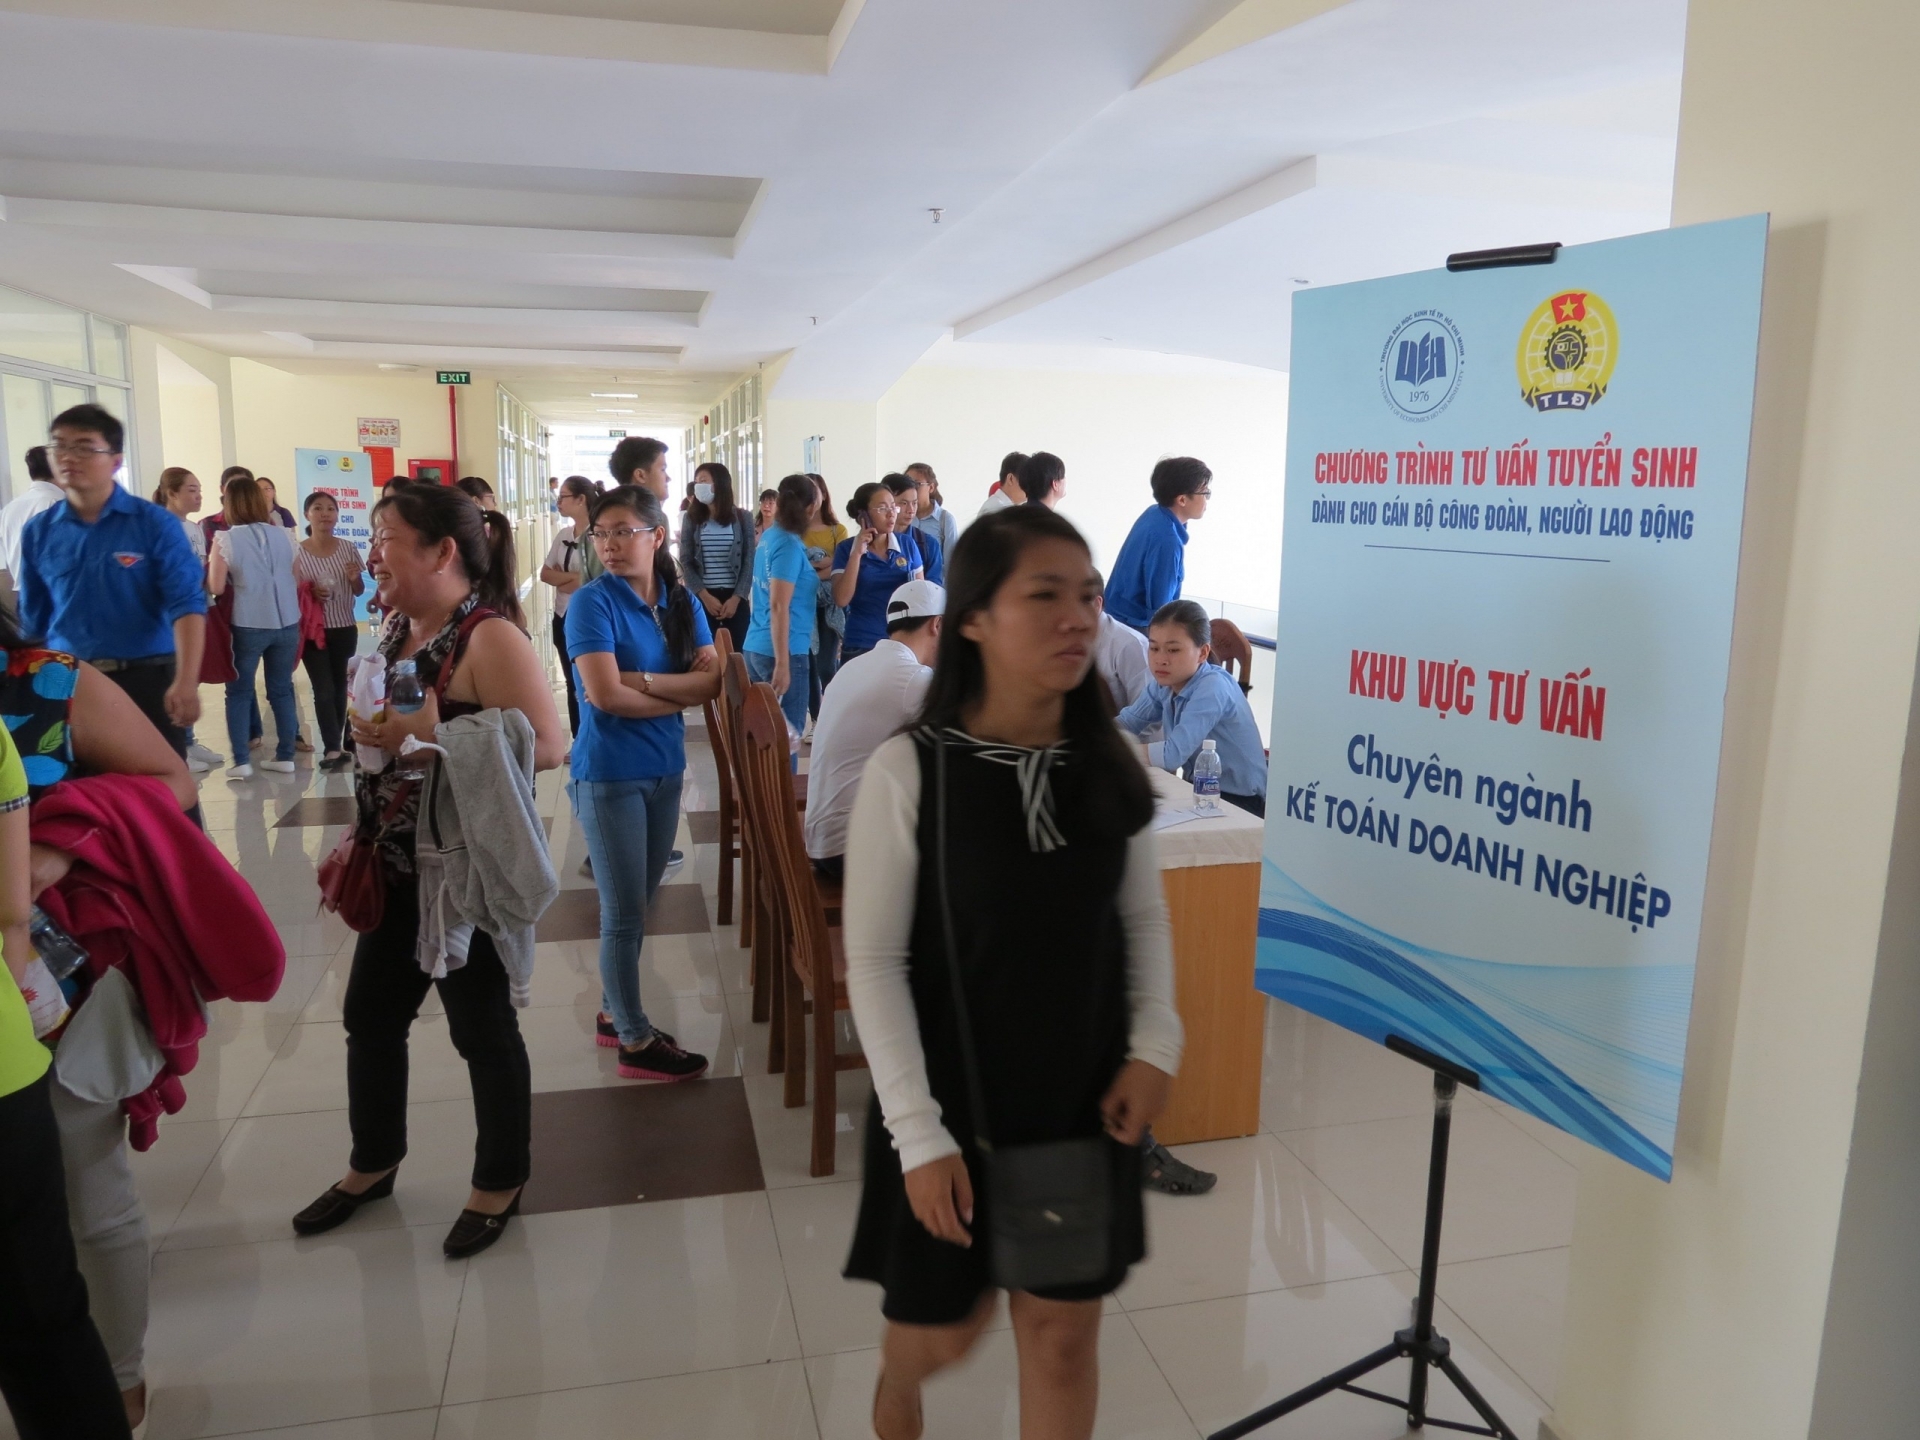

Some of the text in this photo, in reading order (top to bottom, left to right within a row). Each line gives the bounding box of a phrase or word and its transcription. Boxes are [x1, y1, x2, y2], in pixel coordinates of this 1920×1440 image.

[440, 373, 468, 383] EXIT
[1409, 391, 1430, 402] 1976
[1540, 393, 1586, 408] TLĐ
[1314, 431, 1698, 488] CHƯƠNG TRÌNH TƯ VẤN TUYỂN SINH
[1312, 493, 1694, 543] DÀNH CHO CÁN BỘ CÔNG ĐOÀN, NGƯỜI LAO ĐỘNG
[1349, 649, 1606, 741] KHU VỰC TƯ VẤN
[1347, 733, 1592, 832] Chuyên ngành
[1286, 780, 1672, 934] KẾ TOÁN DOANH NGHIỆP
